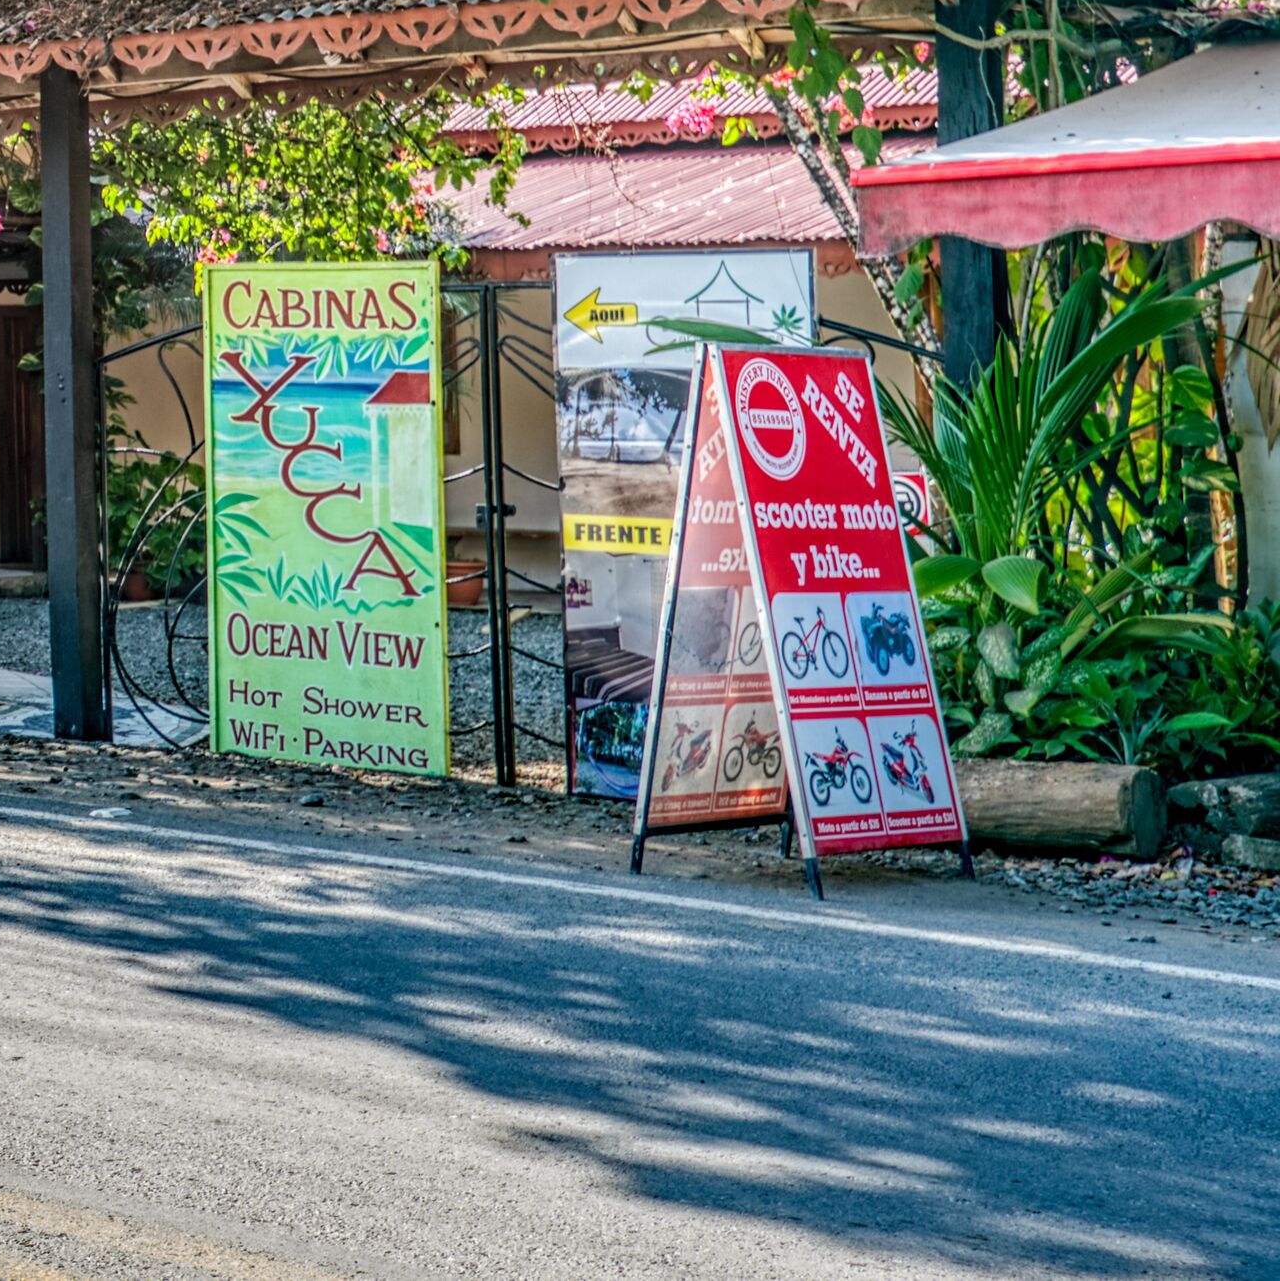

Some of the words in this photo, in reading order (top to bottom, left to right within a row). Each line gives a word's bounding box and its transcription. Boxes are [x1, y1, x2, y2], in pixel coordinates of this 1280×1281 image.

[222, 279, 417, 331] CABINAS
[740, 365, 764, 415] MISTERY
[765, 367, 799, 417] JUNGLE
[834, 371, 865, 423] SE
[801, 374, 878, 489] RENTA
[219, 351, 422, 597] YUCCA
[574, 523, 662, 546] FRENTE
[754, 498, 838, 529] scooter
[841, 499, 896, 531] moto
[791, 551, 807, 586] y
[810, 544, 880, 579] bike...
[227, 612, 329, 661] OCEAN
[336, 621, 426, 669] VIEW
[229, 679, 282, 708] HOT
[303, 687, 429, 727] SHOWER
[303, 727, 429, 768] PARKING
